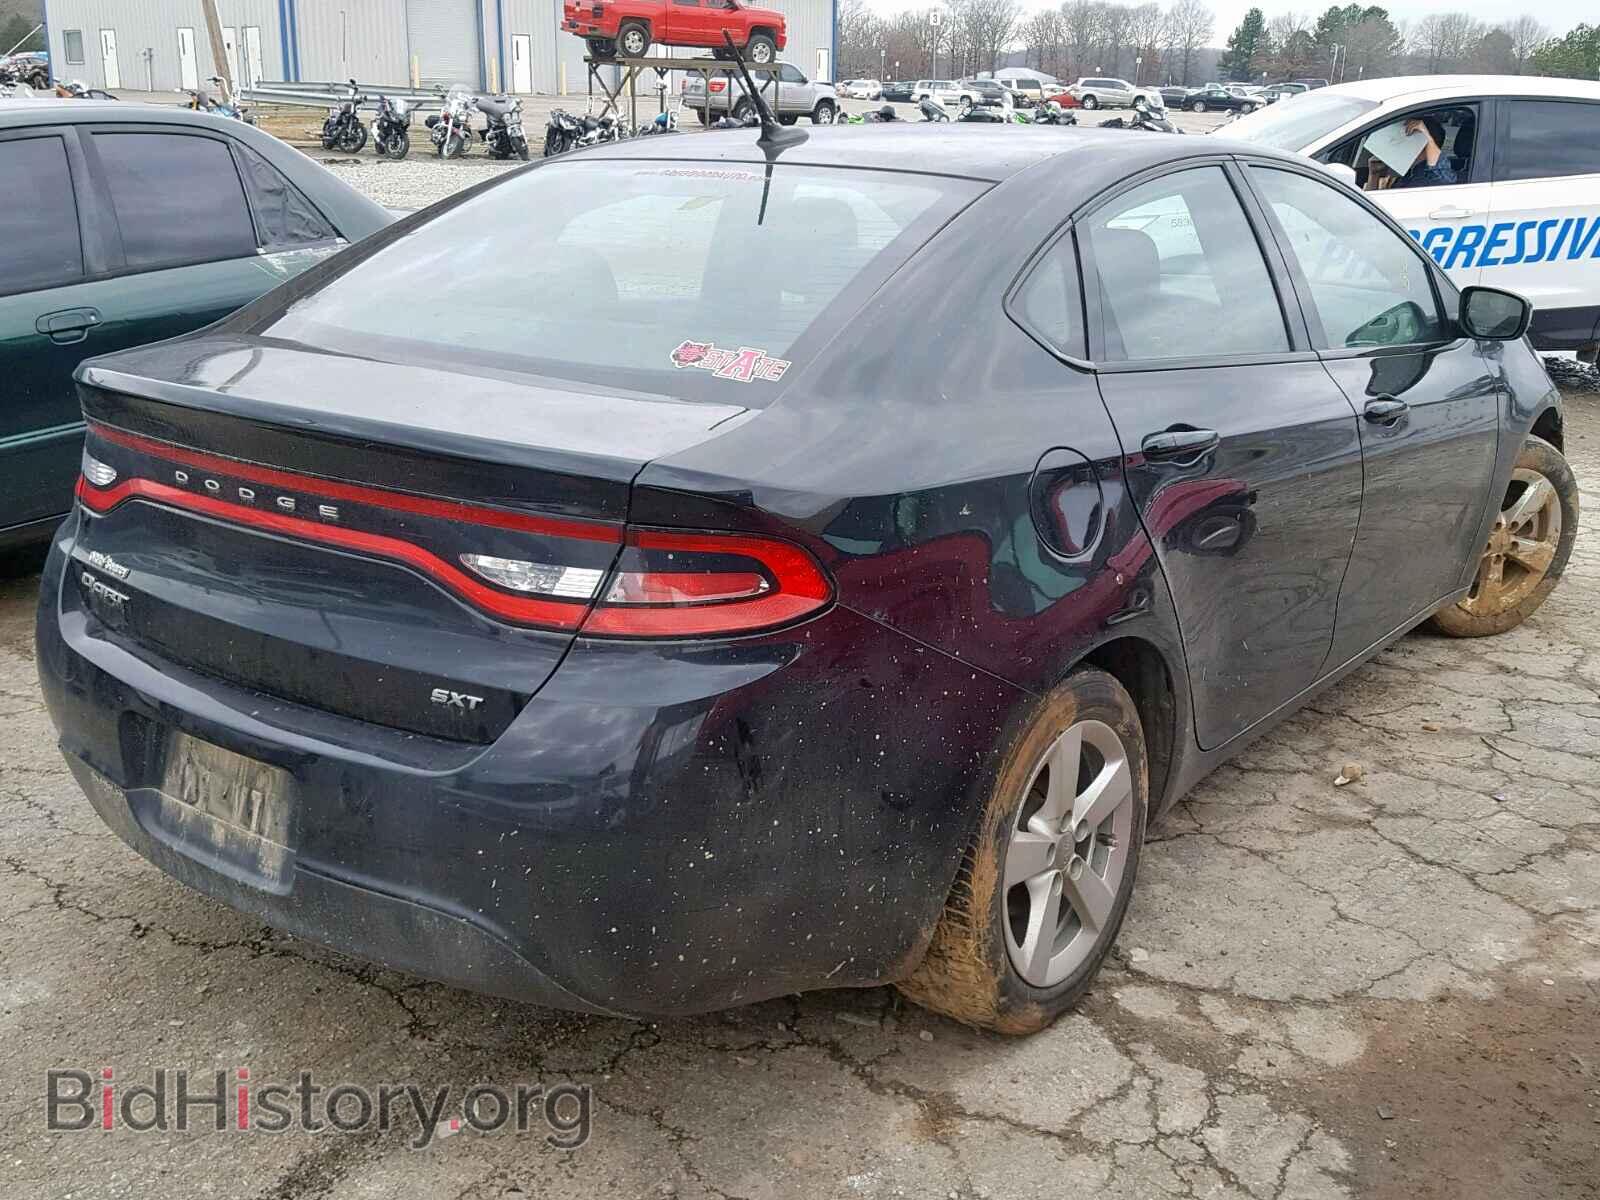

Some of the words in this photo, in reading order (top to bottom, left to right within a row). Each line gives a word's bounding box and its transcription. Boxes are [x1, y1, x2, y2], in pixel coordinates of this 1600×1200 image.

[1407, 216, 1600, 270] GRESSIV
[175, 470, 339, 519] DODGE
[430, 688, 484, 710] SXT
